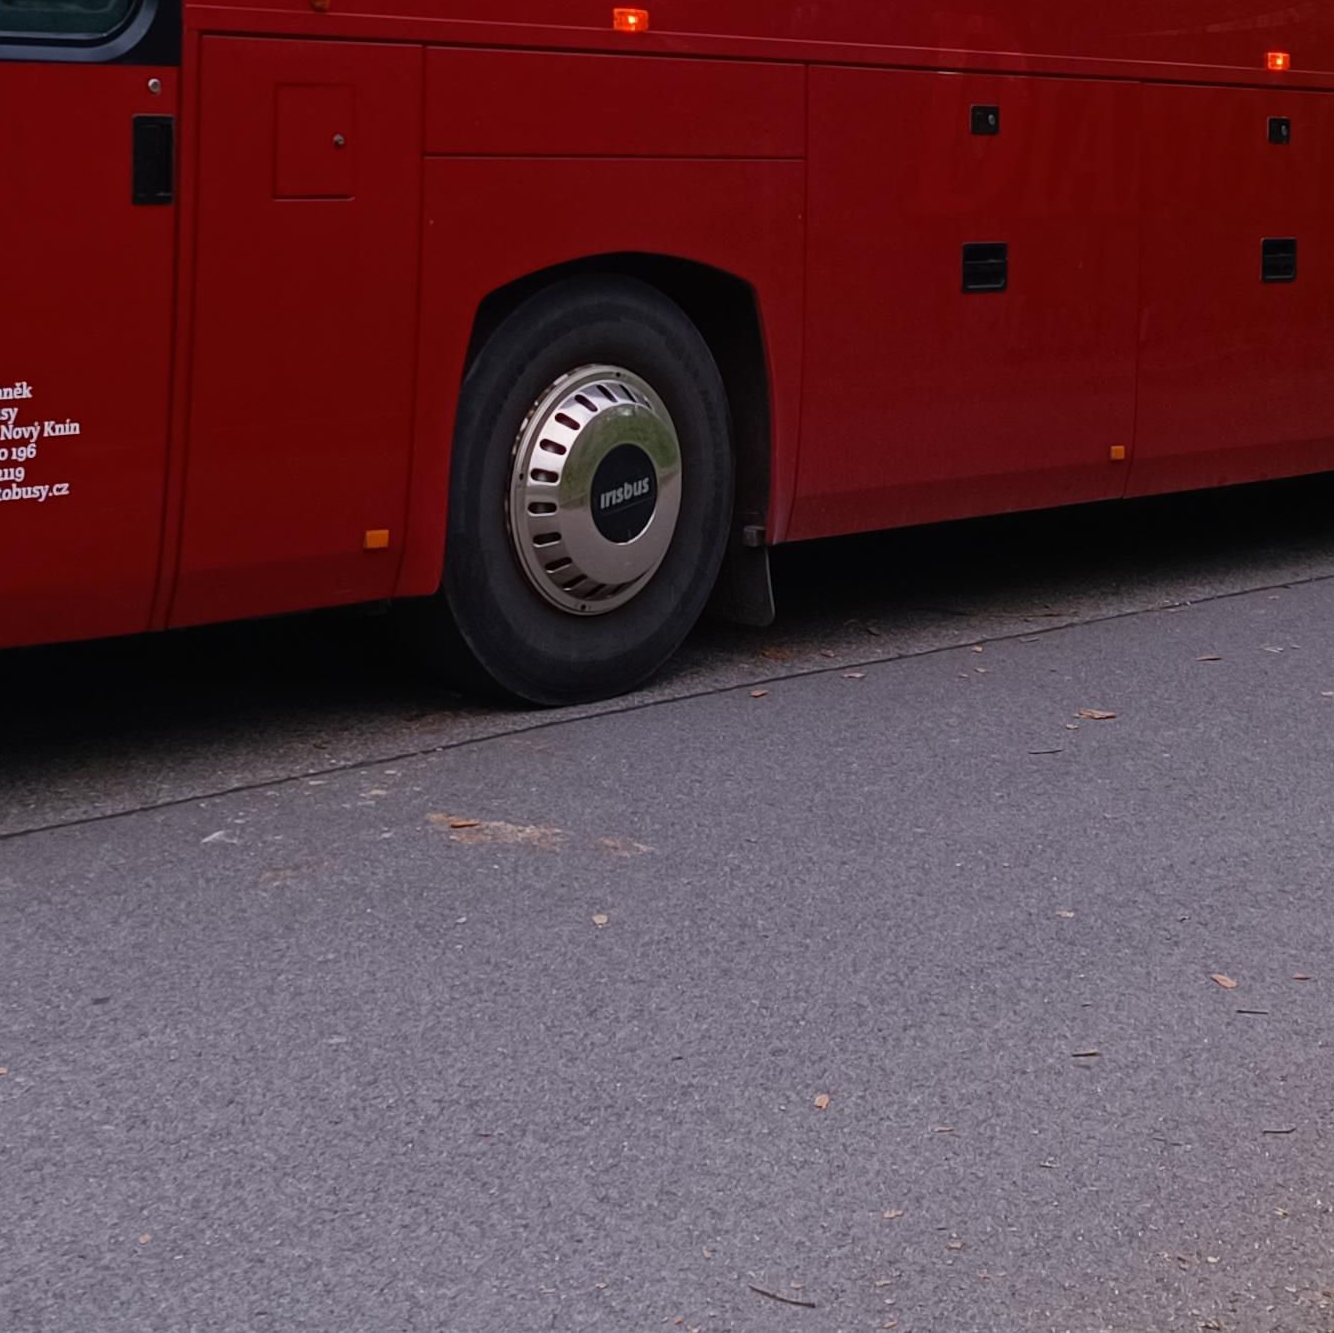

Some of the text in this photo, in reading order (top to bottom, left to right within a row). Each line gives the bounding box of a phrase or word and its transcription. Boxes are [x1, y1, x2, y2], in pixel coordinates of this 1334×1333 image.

[0, 421, 41, 442] Nový
[43, 418, 81, 437] Knín
[11, 443, 37, 461] 196
